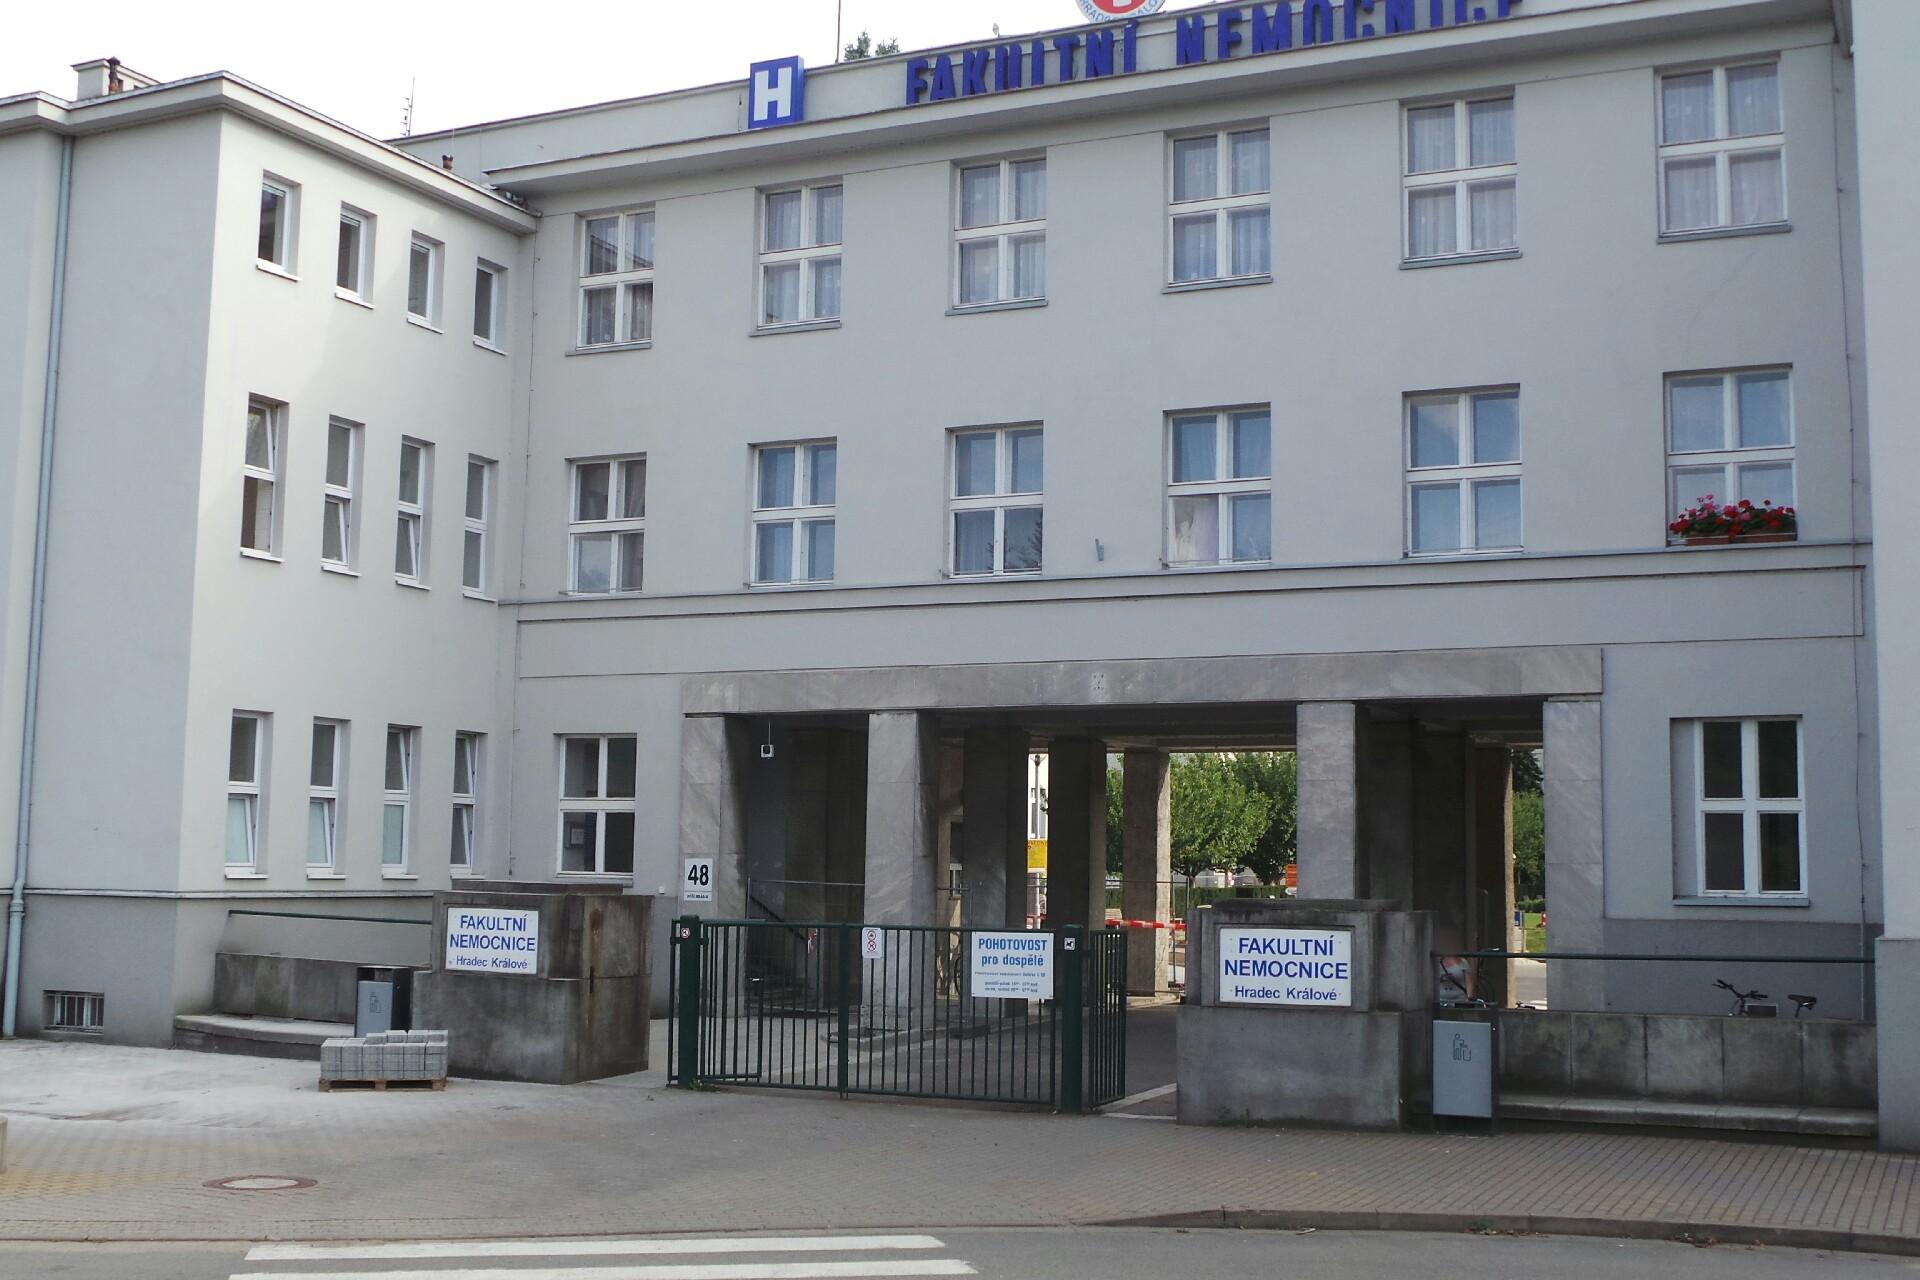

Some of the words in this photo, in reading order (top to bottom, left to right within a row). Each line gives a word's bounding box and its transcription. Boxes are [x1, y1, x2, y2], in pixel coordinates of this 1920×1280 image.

[753, 67, 792, 121] H
[687, 864, 709, 886] 48
[460, 913, 528, 932] FAKULTNÍ
[449, 933, 536, 951] NEMOCNICE
[978, 938, 1048, 951] POHOTOVOST
[1238, 934, 1335, 956] FAKULTNÍ
[456, 955, 487, 967] Hradec
[491, 957, 528, 969] Králové
[981, 955, 998, 967] pro
[1002, 954, 1044, 968] dospělé
[1224, 959, 1348, 980] NEMOCNICE
[1234, 985, 1280, 999] Hradec
[1286, 986, 1337, 1001] Králové
